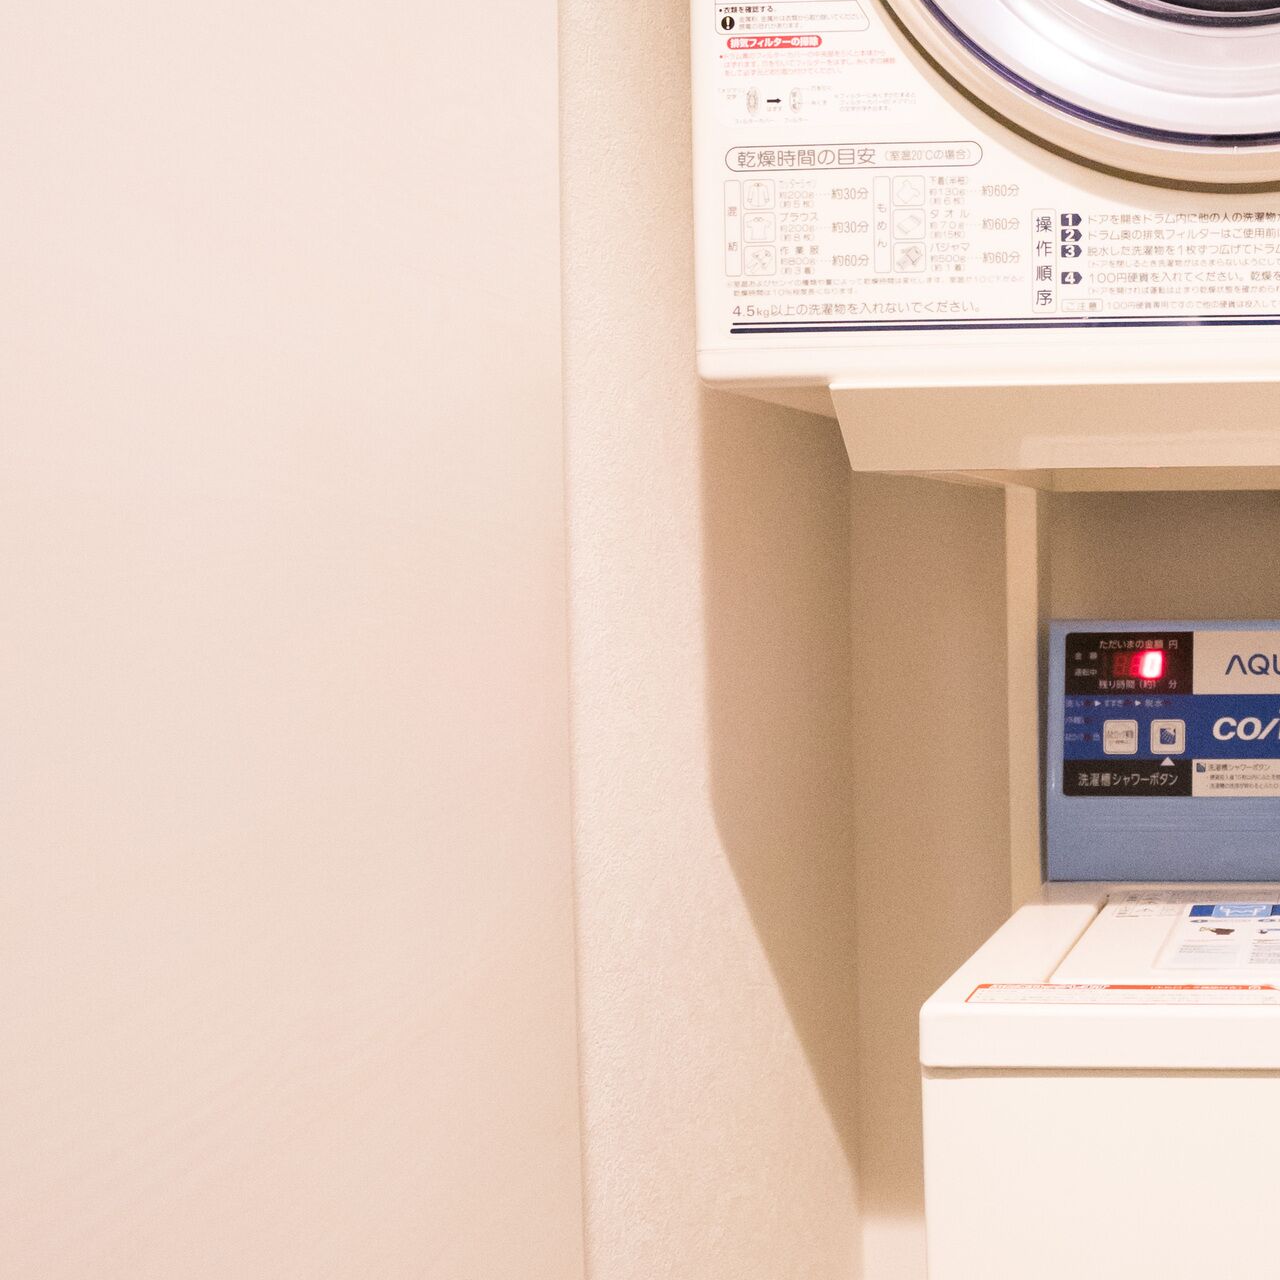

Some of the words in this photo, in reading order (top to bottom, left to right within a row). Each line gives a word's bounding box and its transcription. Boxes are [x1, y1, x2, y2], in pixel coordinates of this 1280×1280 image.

[737, 148, 876, 168] 乾燥時間の目安
[831, 188, 870, 200] 約30分
[981, 184, 1020, 197] 約60分
[831, 221, 870, 234] 約30分
[982, 218, 1021, 230] 約60分
[831, 254, 871, 268] 約60分
[982, 251, 1021, 265] 約60分
[1036, 215, 1053, 306] 操作順序
[732, 301, 982, 318] 4.5kg以上の洗濯物を入れないでください。
[1099, 639, 1164, 649] ただいまの金額
[1168, 639, 1178, 649] 円
[1168, 679, 1178, 690] 分
[1077, 773, 1180, 787] 洗濯槽シャワーボタン
